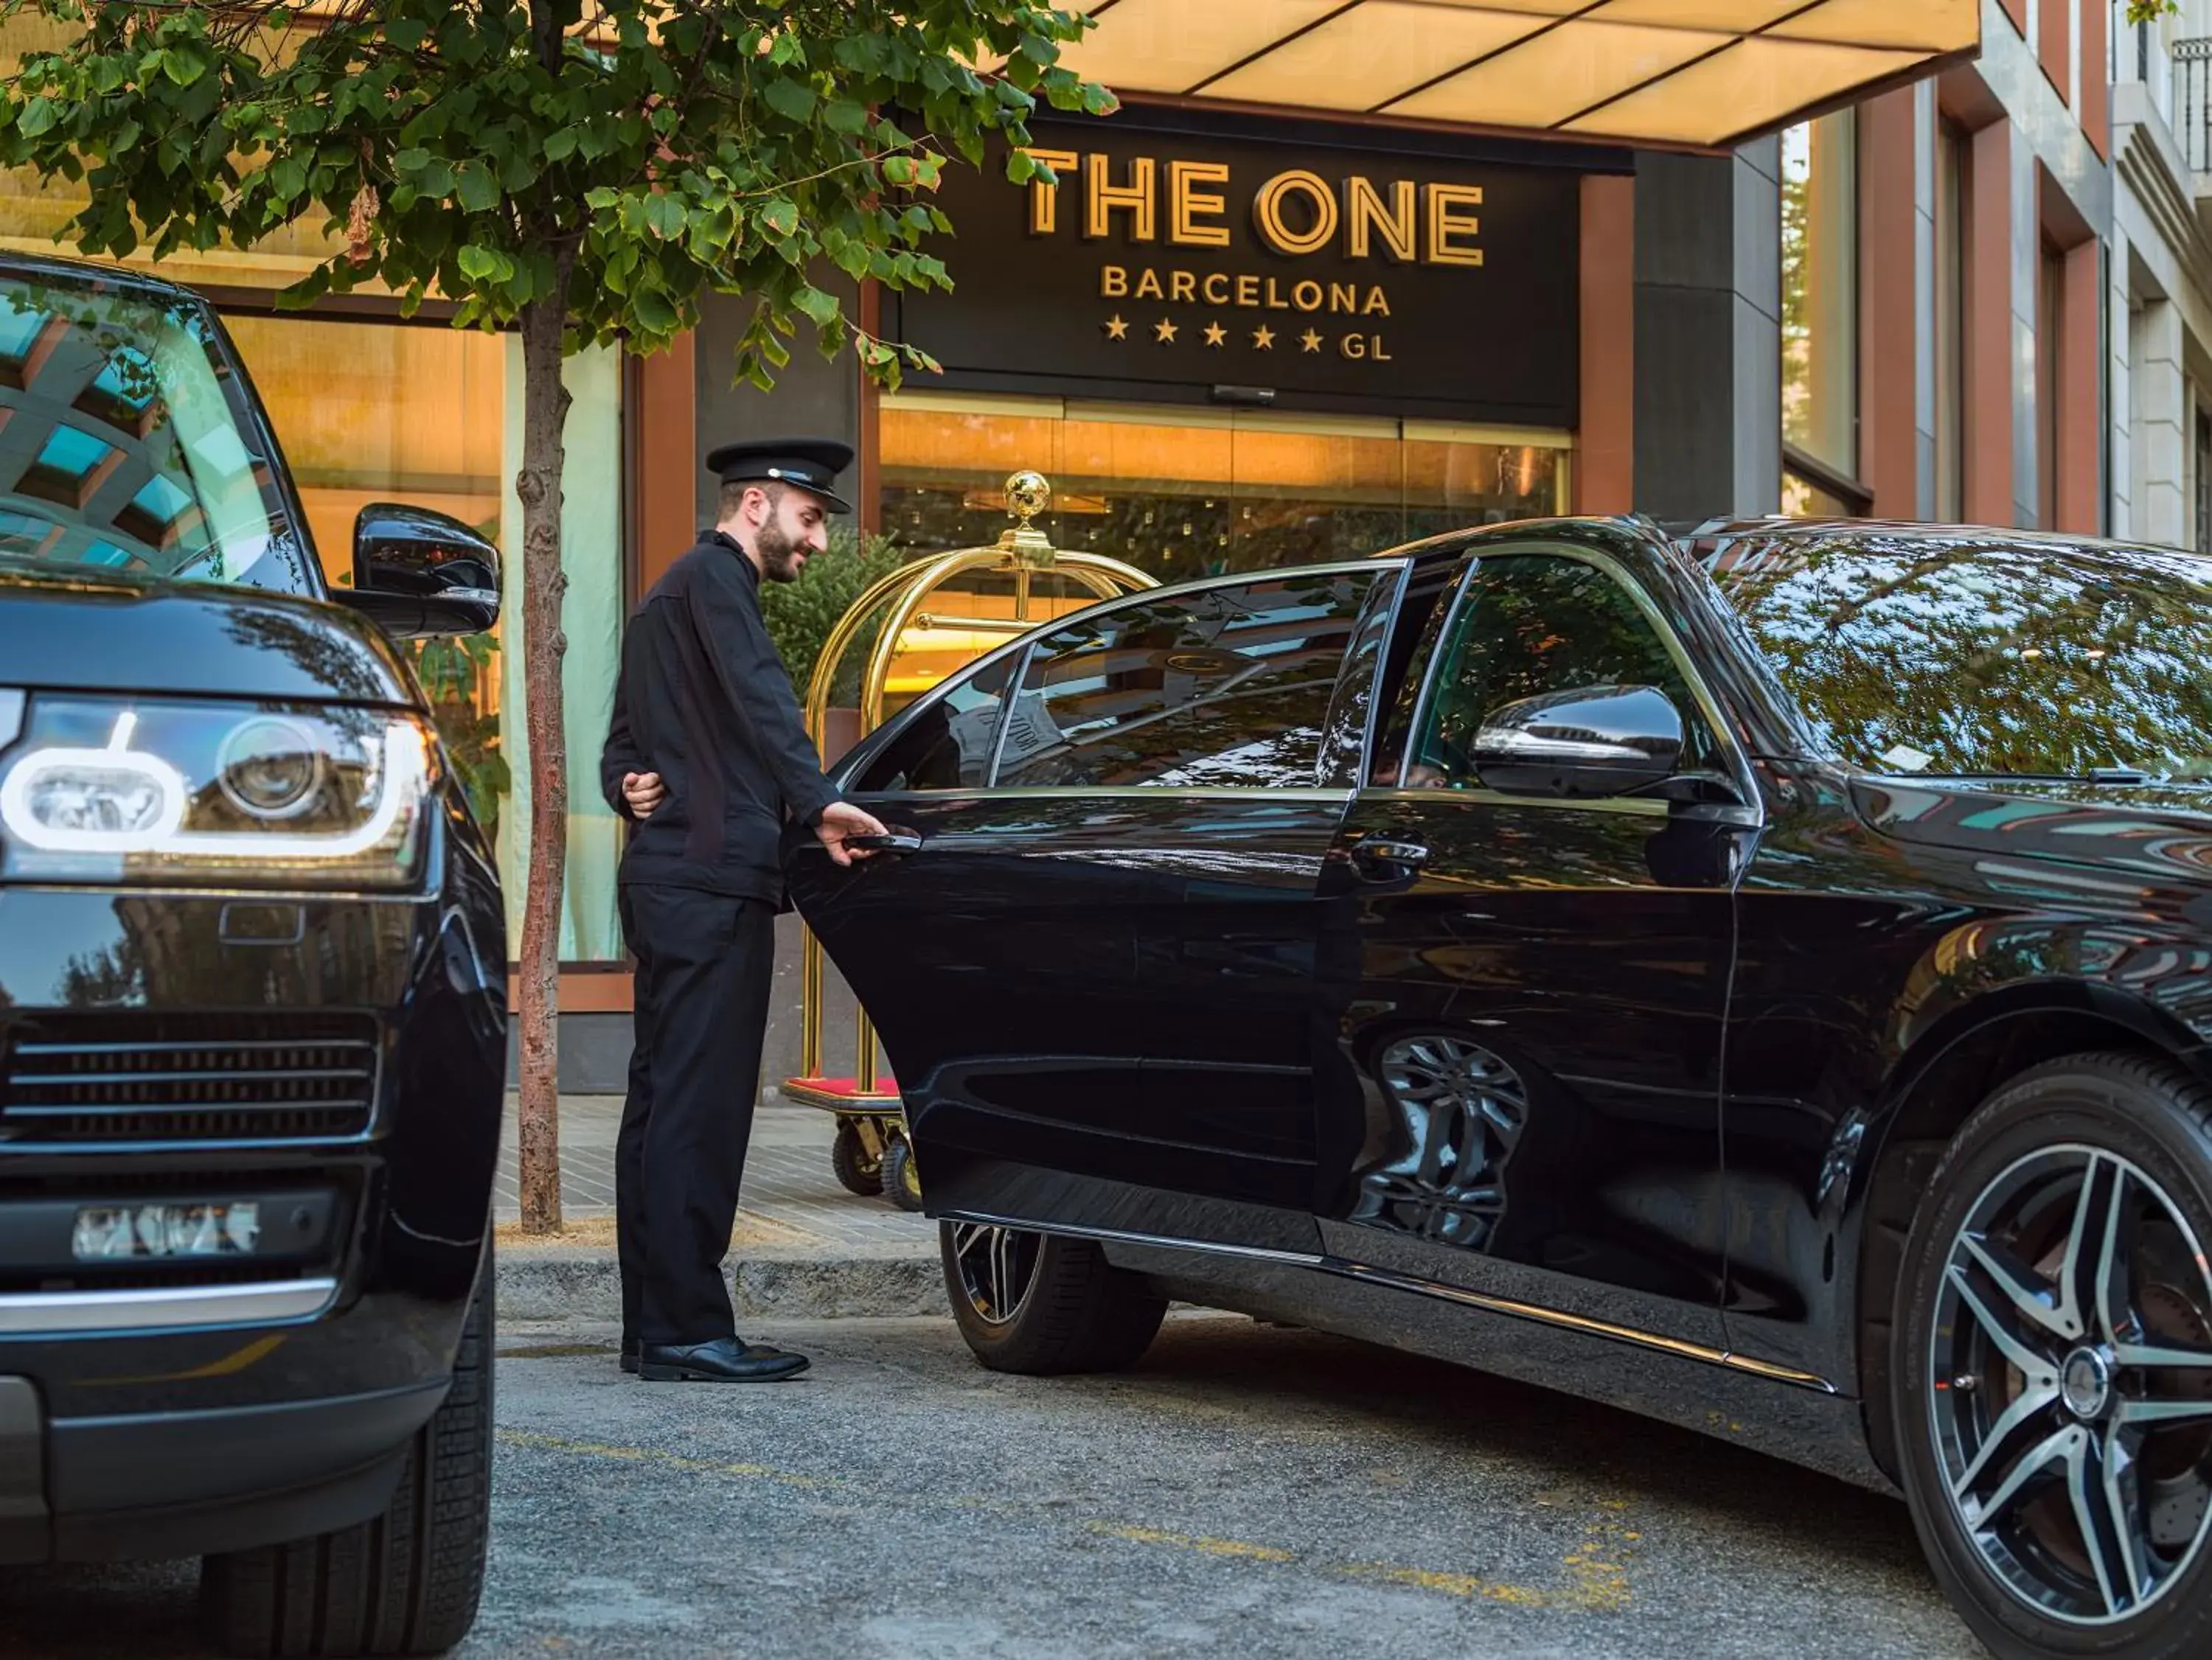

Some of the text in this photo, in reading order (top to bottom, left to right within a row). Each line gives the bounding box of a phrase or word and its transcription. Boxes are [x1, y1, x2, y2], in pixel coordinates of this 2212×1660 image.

[1015, 147, 1483, 266] THE ONE
[1103, 265, 1391, 317] BARCELONA
[1341, 332, 1391, 360] GL
